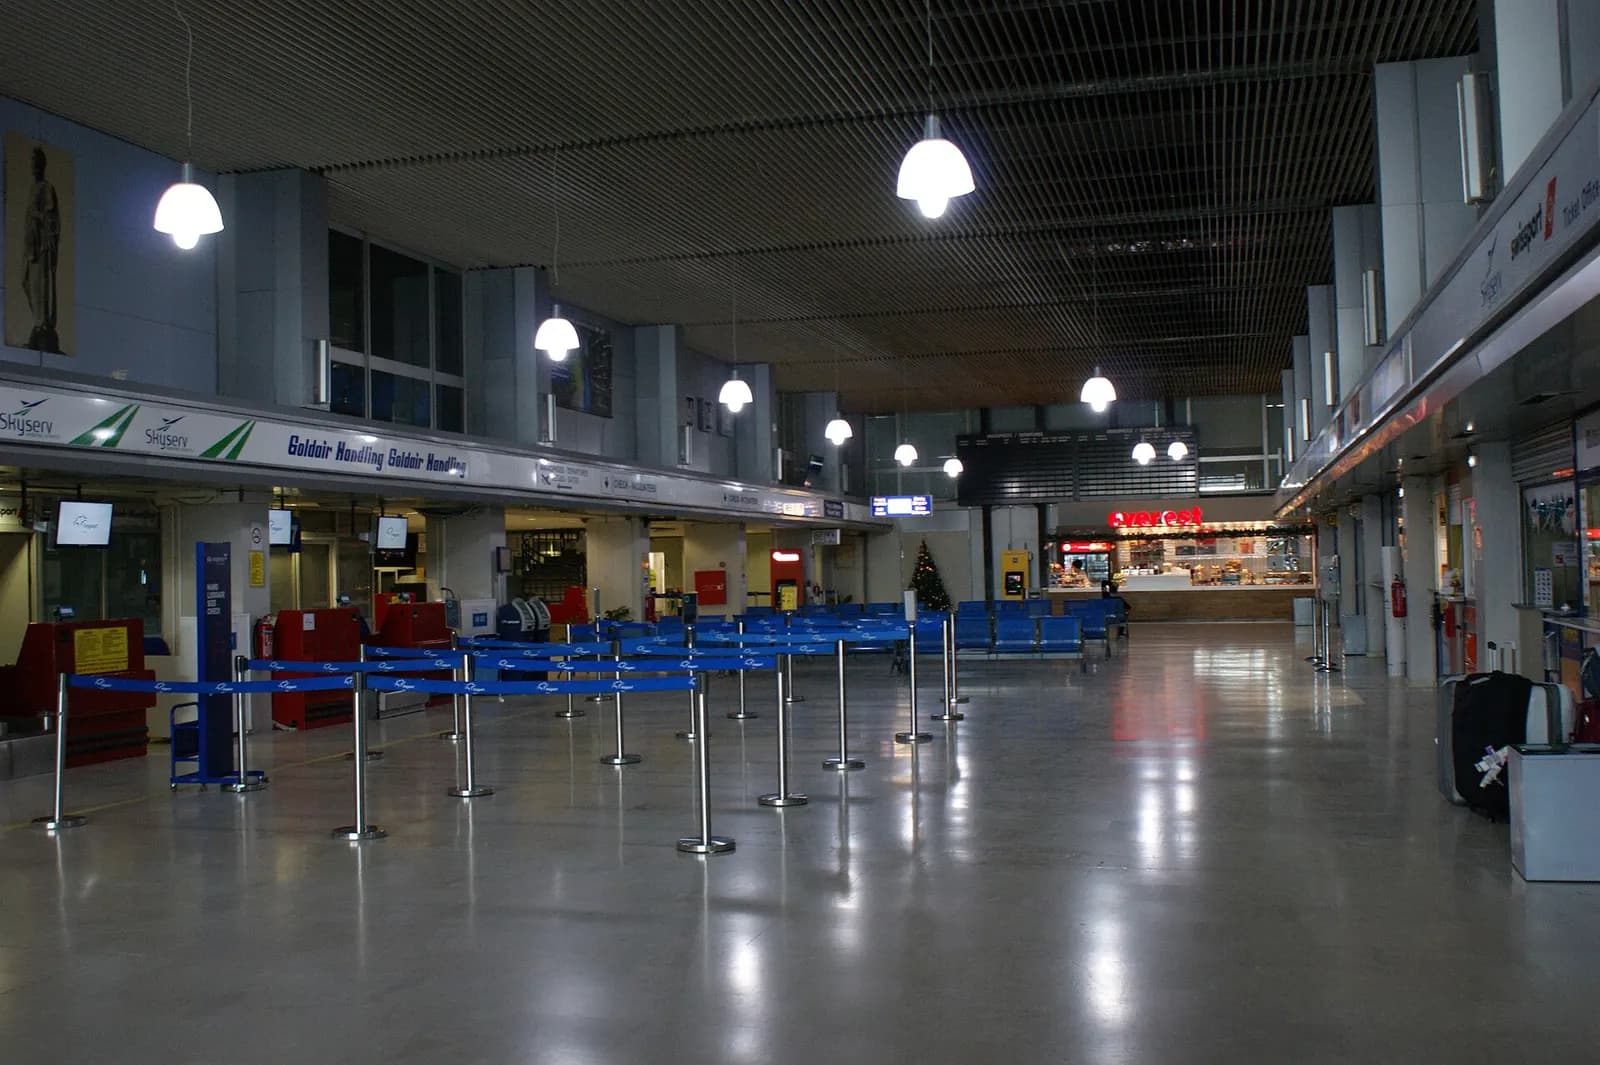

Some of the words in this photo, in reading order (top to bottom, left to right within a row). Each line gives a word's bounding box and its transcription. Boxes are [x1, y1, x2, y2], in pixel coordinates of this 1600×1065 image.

[0, 412, 53, 437] Skyserv
[145, 428, 188, 450] Skyserv
[288, 435, 333, 460] Goldair
[335, 441, 384, 472] Handling
[388, 448, 424, 470] Goldair
[1107, 505, 1203, 529] everest
